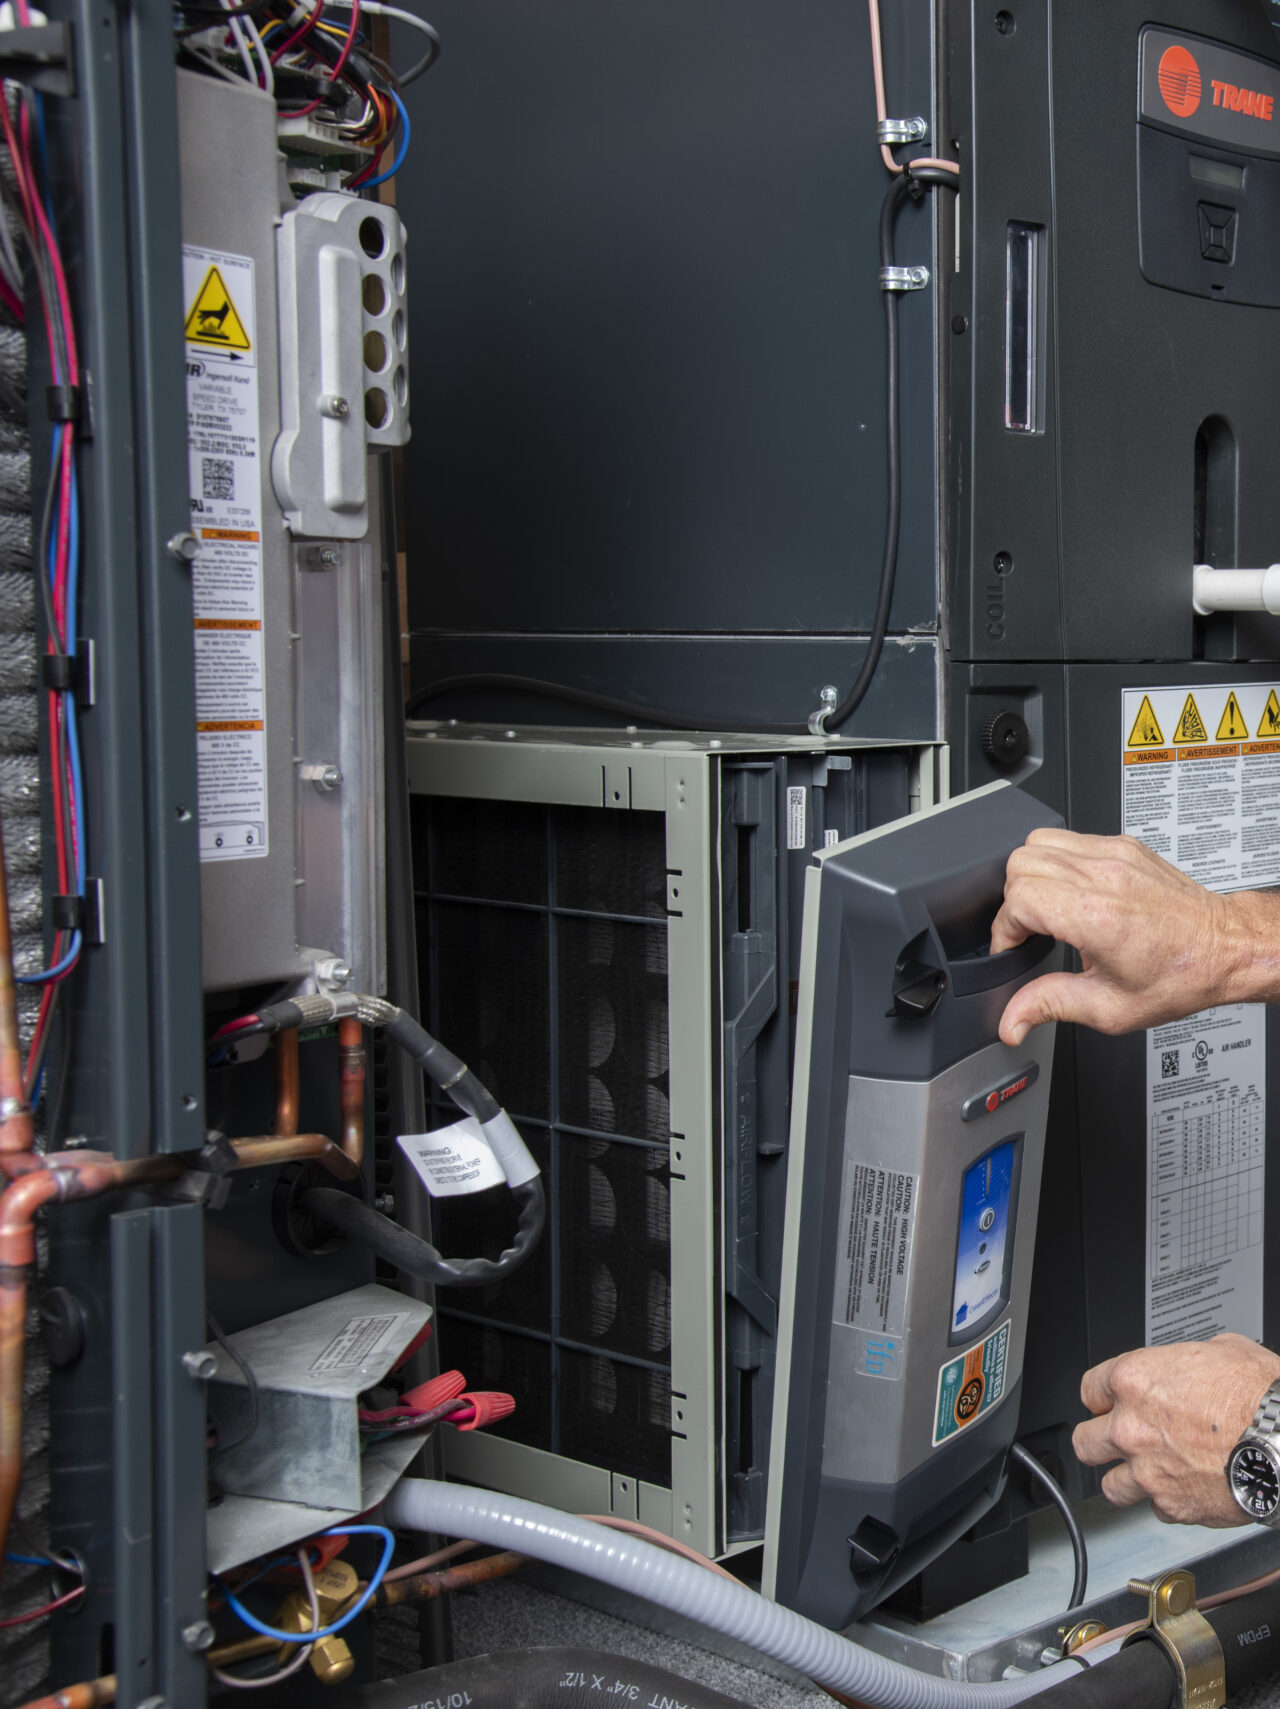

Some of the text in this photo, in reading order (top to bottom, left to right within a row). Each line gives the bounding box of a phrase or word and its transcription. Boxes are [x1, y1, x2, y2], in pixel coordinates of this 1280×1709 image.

[1211, 80, 1274, 121] TRANE
[199, 384, 231, 394] VARIABLE
[986, 577, 1005, 641] COIL
[1137, 752, 1169, 761] WARNING
[1186, 746, 1237, 758] AVERTISSEMENT
[1230, 1038, 1252, 1050] HANDLER
[1001, 1077, 1028, 1101] TRANE
[740, 1114, 753, 1205] AIRFLOW
[865, 1168, 876, 1216] ATTENTION:
[894, 1174, 904, 1214] CAUTION:
[867, 1170, 885, 1284] ATTENTION: HAUTE TENSION
[896, 1175, 912, 1275] CAUTION: HIGH VOLTAGE
[994, 1328, 1007, 1399] CERTIFIED
[1255, 1499, 1265, 1510] 12
[1237, 1624, 1271, 1647] EPDM
[560, 1672, 587, 1687] 1/2"
[591, 1674, 606, 1690] X
[606, 1680, 640, 1700] 3/4"
